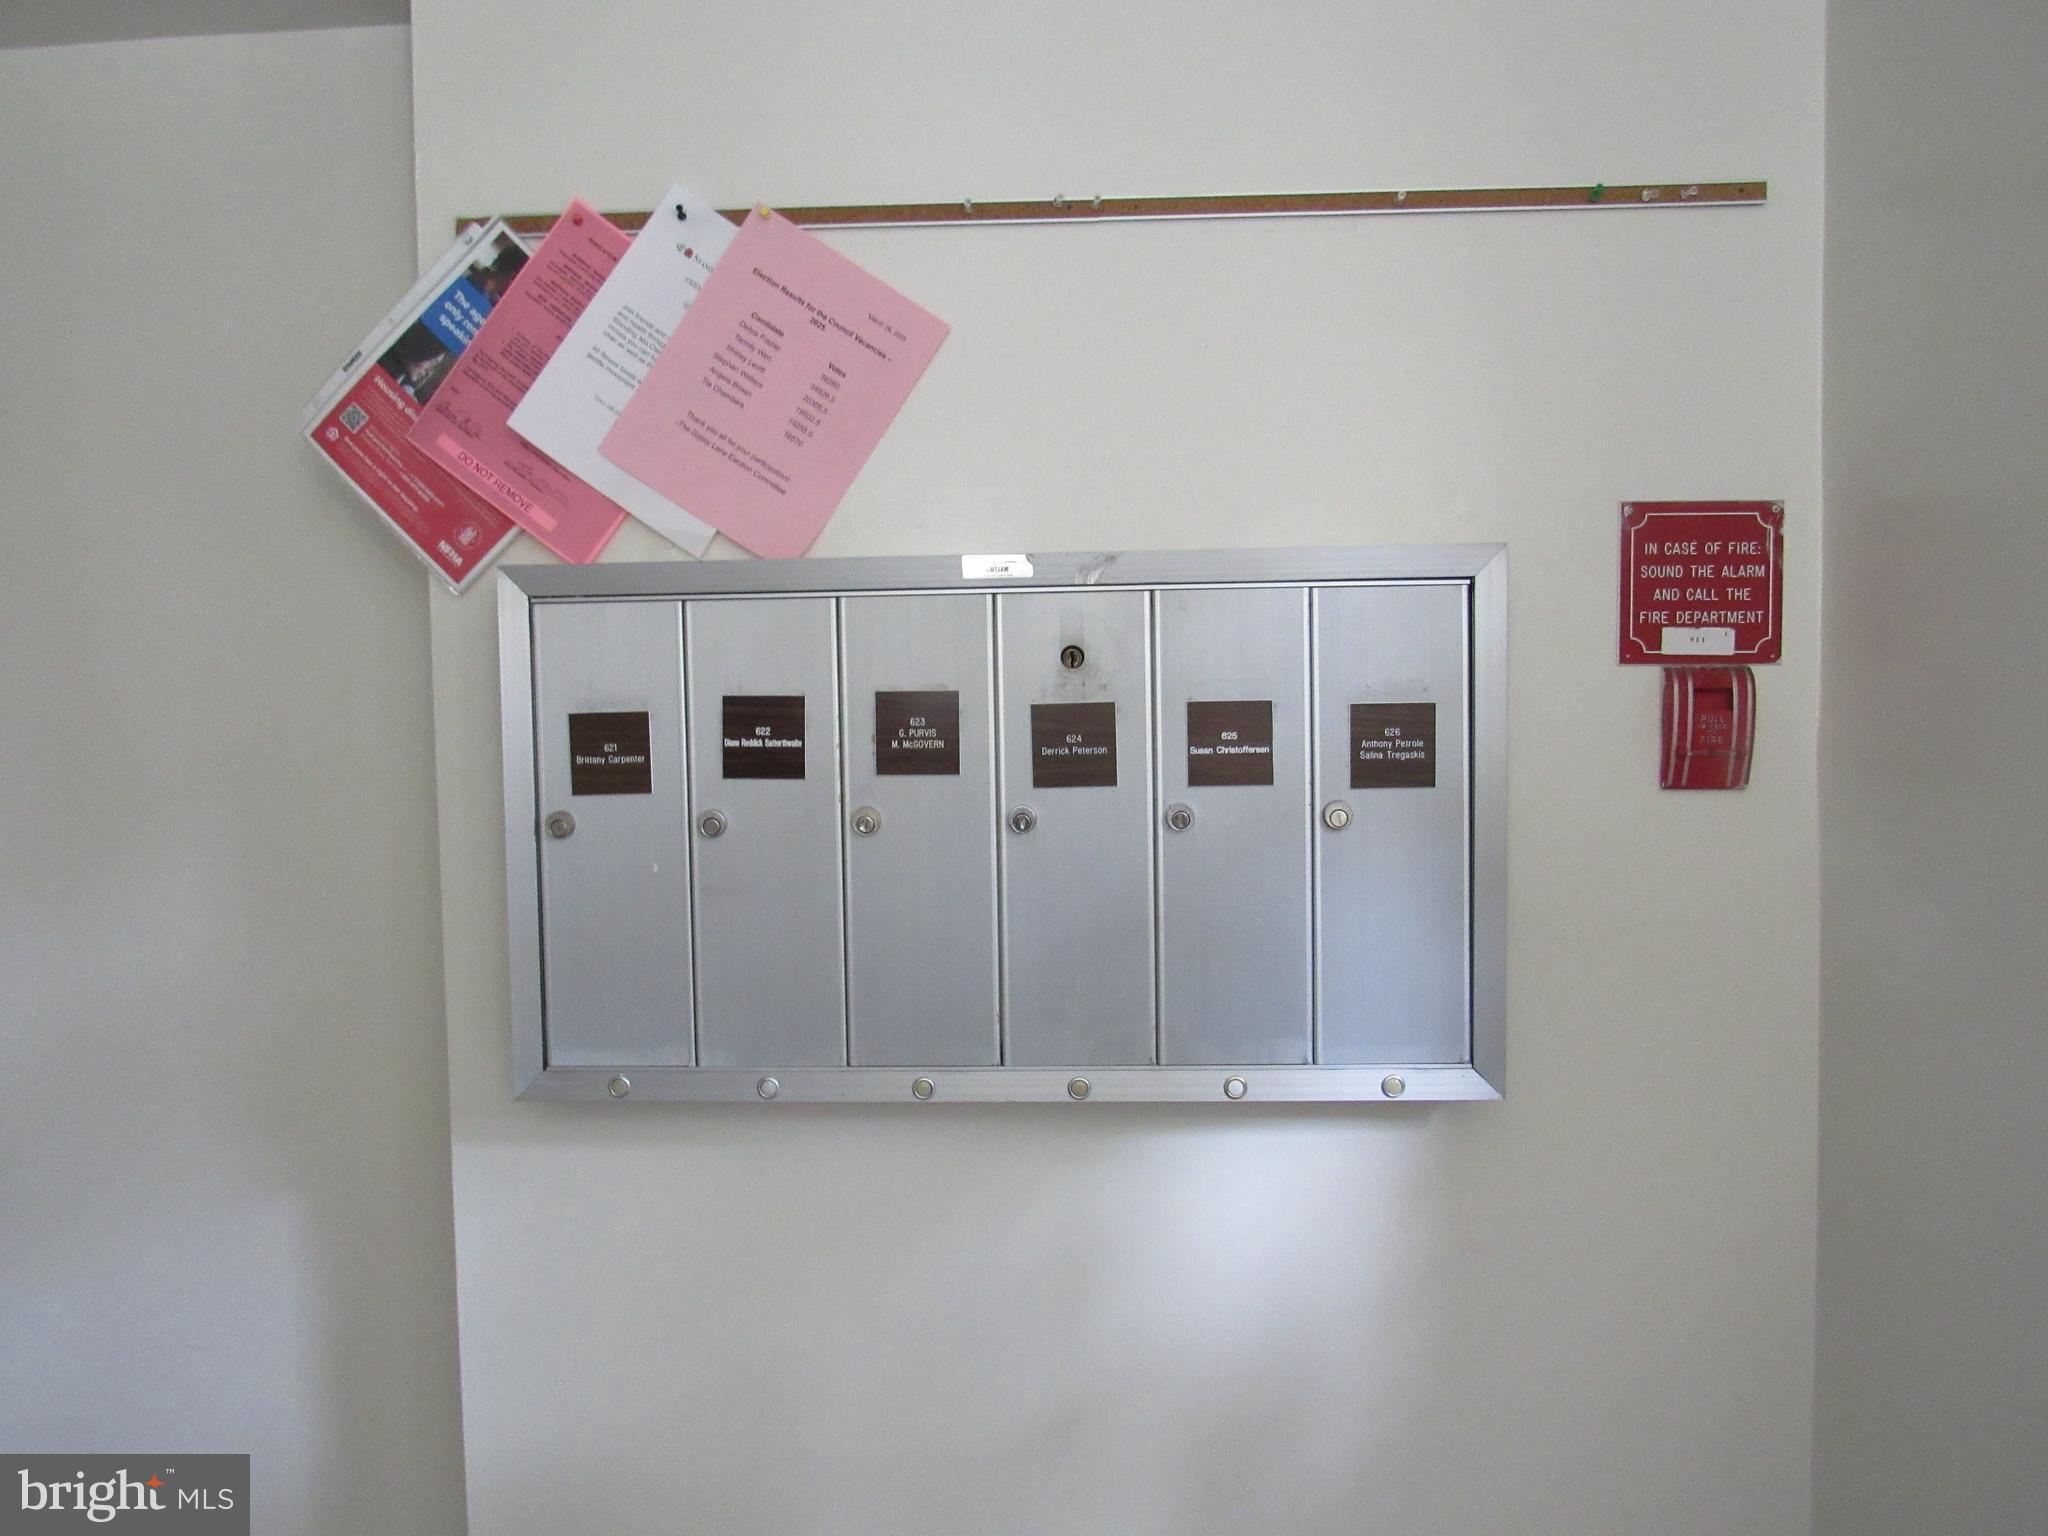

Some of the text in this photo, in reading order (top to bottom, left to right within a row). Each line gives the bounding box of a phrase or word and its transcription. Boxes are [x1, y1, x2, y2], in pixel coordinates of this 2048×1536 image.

[454, 290, 470, 308] The
[444, 302, 464, 321] only
[753, 267, 780, 289] Election
[780, 286, 805, 306] Results
[806, 302, 816, 313] for
[817, 309, 827, 320] the
[828, 318, 854, 338] Council
[854, 334, 887, 359] Vacancies
[752, 312, 784, 337] Candidate
[829, 362, 847, 378] Votes
[374, 376, 405, 410] Housing
[688, 410, 705, 427] Thank
[706, 425, 718, 436] you
[737, 445, 751, 456] your
[728, 452, 752, 473] Election
[753, 470, 786, 495] Committee
[458, 451, 473, 466] DO
[473, 463, 494, 481] NOT
[493, 479, 534, 513] REMOVE
[1644, 542, 1761, 555] IN CASE OF FIRE:
[1640, 565, 1765, 578] SOUND THE ALARM
[1653, 588, 1751, 601] AND CALL THE
[1639, 611, 1764, 624] FIRE DEPARTMENT
[910, 717, 926, 726] 623
[755, 726, 771, 736] 622
[899, 728, 937, 737] G. PURVIS
[1221, 732, 1238, 740] 625
[1384, 728, 1400, 736] 626
[741, 738, 763, 748] Reddick
[1066, 734, 1082, 743] 624
[1361, 739, 1424, 749] Anthony Petrole
[604, 744, 618, 752] 621
[891, 740, 945, 749] M. McGOVERN
[1190, 746, 1270, 754] Susan Christoffersen
[1041, 746, 1108, 755] Derrick Peterson
[1360, 751, 1425, 760] Salina Tregaskis
[576, 755, 645, 766] Brittany Carpenter
